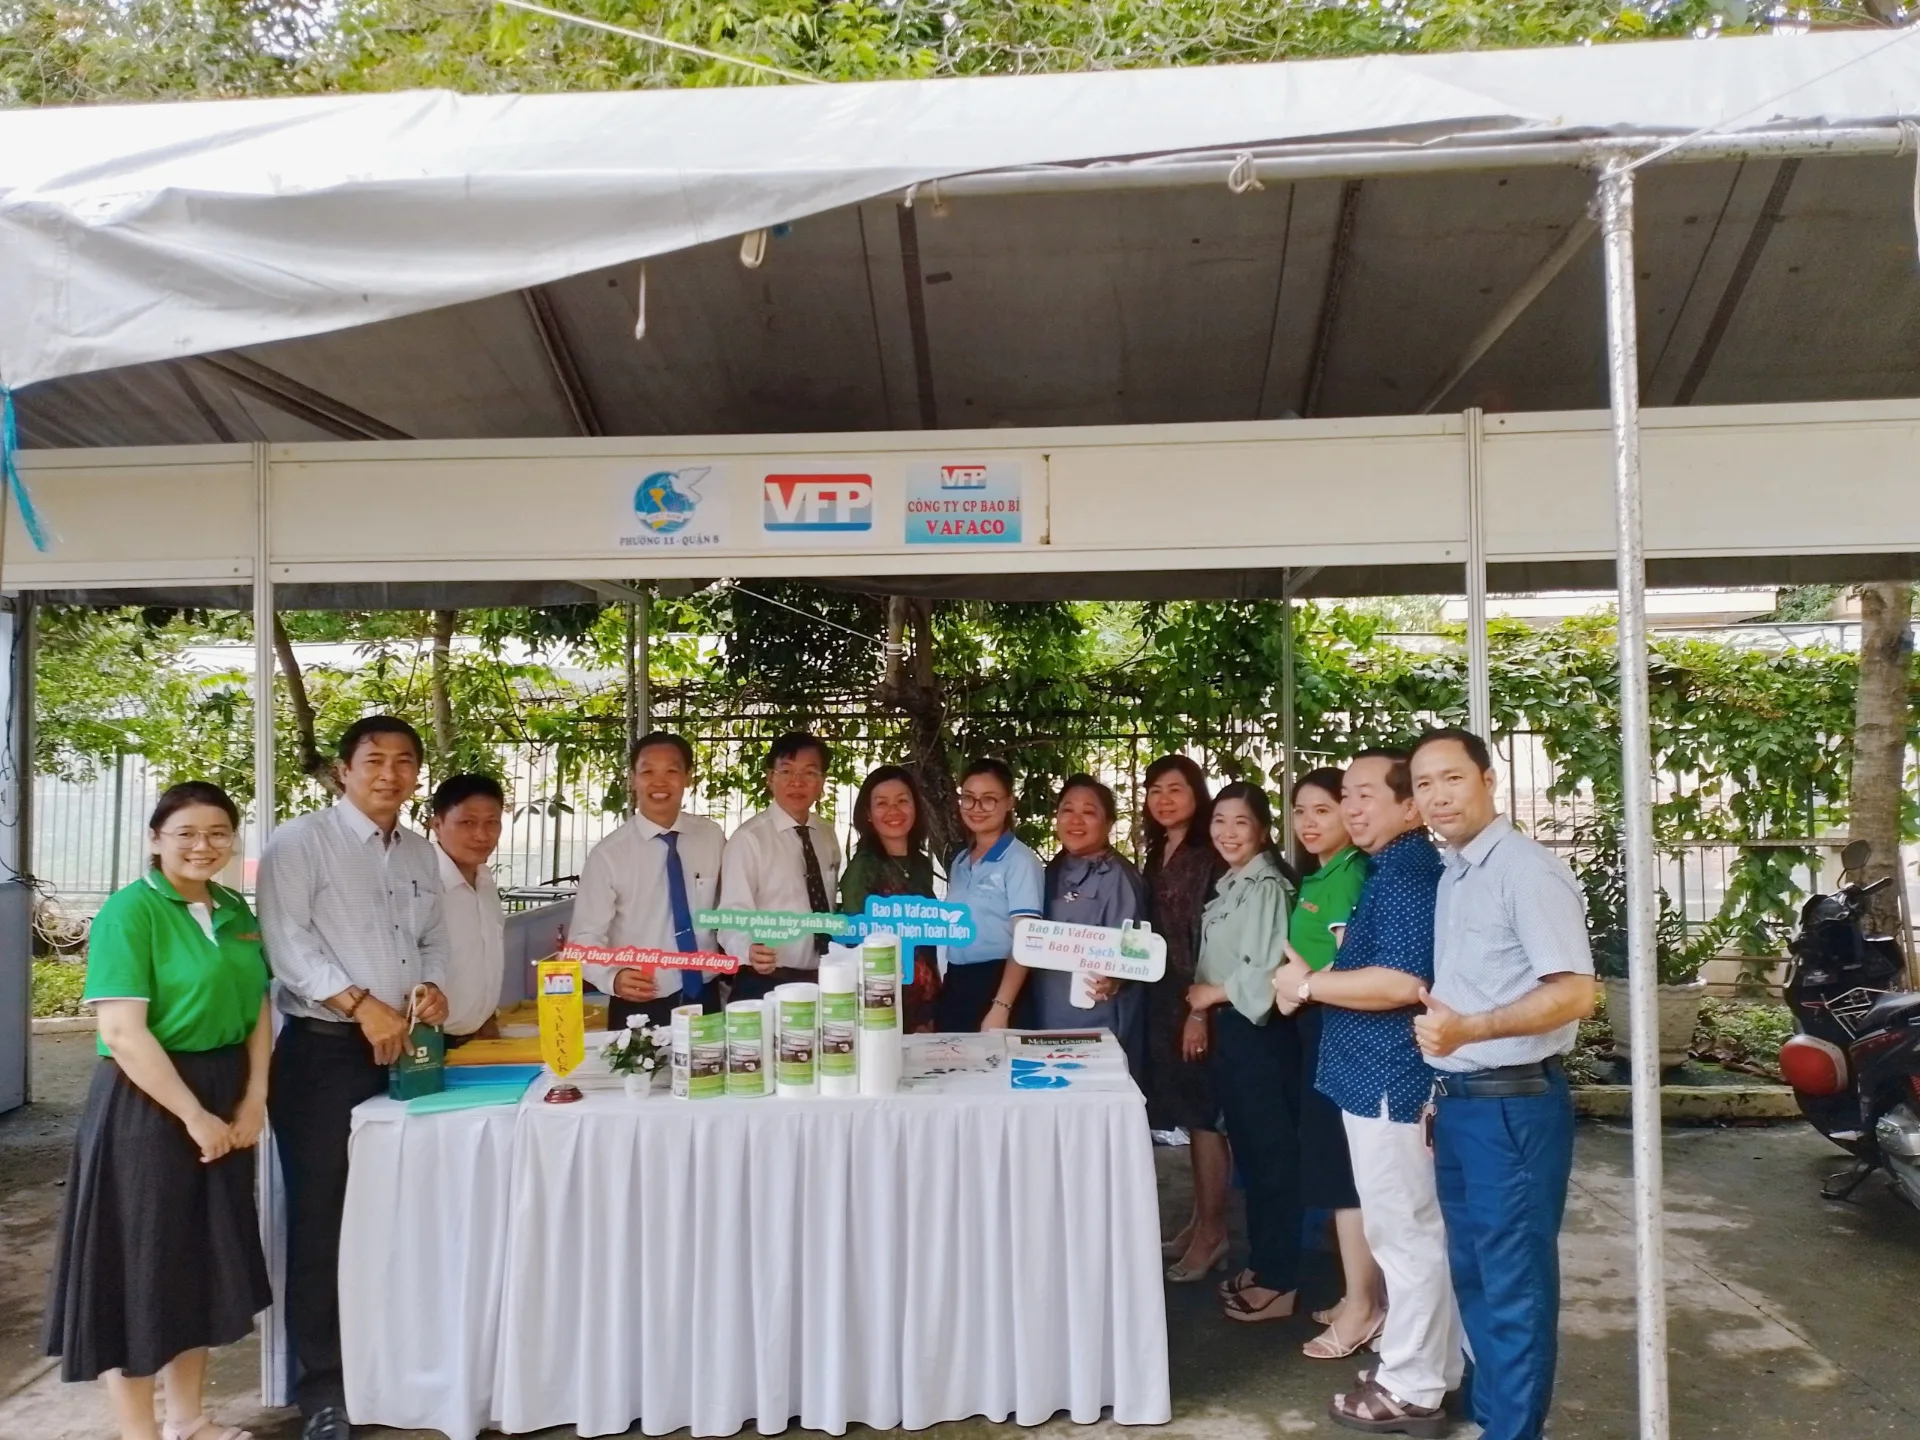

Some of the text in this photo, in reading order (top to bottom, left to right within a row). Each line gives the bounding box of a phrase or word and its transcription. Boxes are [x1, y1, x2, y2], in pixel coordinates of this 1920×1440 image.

[942, 467, 986, 487] VFP
[764, 481, 872, 524] VFP
[907, 497, 940, 512] CÔNG
[943, 501, 959, 512] TY
[962, 501, 977, 512] CP
[980, 500, 1005, 512] BAO
[926, 519, 1005, 535] VAFACO
[872, 902, 892, 918] Bao
[905, 903, 939, 919] Vafaco
[699, 913, 720, 924] Bao
[800, 917, 823, 928] sinh
[825, 918, 845, 930] học
[754, 928, 788, 940] Vafaco
[1028, 923, 1049, 934] Bao
[1068, 928, 1106, 940] Vafaco
[1048, 941, 1069, 952] Bao
[587, 950, 614, 963] thay
[636, 952, 659, 964] thói
[660, 955, 688, 967] quen
[706, 956, 735, 970] dụng
[1079, 958, 1100, 969] Bao
[1119, 963, 1150, 976] Xanh
